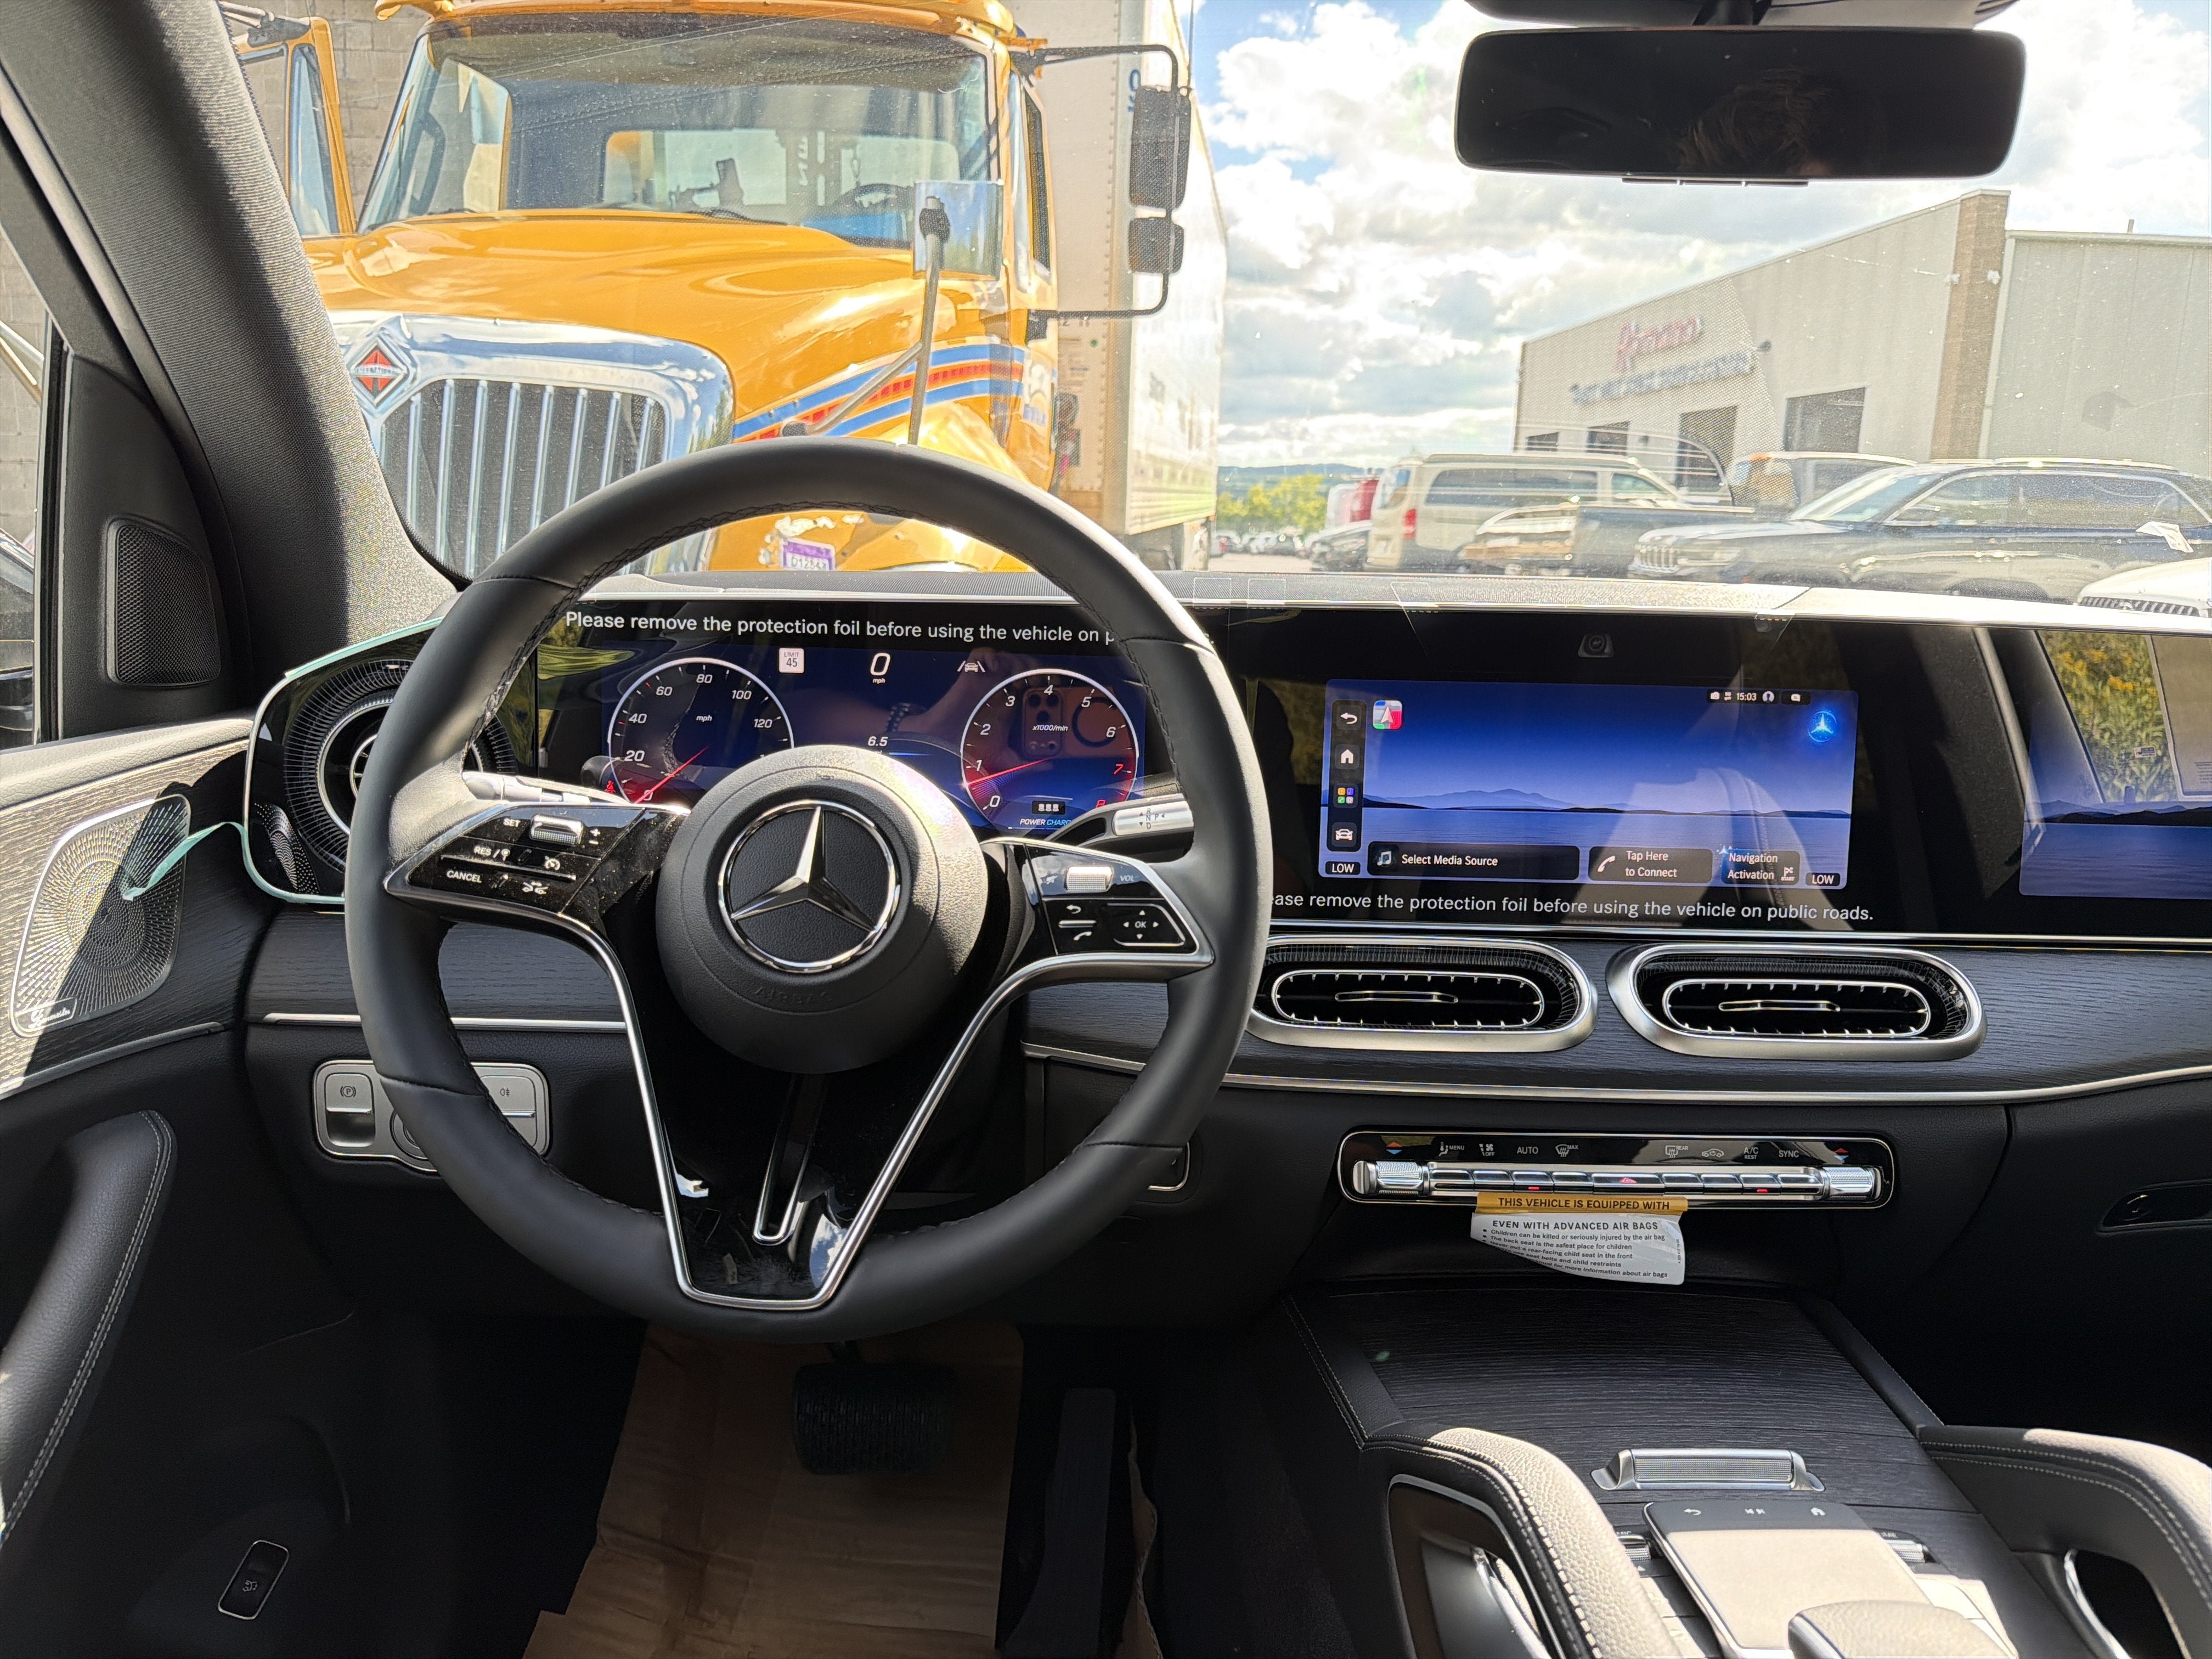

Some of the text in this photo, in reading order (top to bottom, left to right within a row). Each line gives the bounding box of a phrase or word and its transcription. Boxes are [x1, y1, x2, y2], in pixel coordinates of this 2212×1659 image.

[566, 611, 624, 628] Please
[631, 616, 697, 631] remove
[703, 616, 731, 631] the
[737, 617, 828, 635] protection
[834, 620, 860, 636] foil
[867, 621, 921, 638] before
[928, 624, 974, 642] using
[979, 624, 1007, 640] the
[1013, 625, 1073, 642] vehicle
[1079, 630, 1098, 642] on
[786, 658, 797, 667] 45
[870, 652, 890, 676] 0
[696, 673, 713, 684] 80
[656, 686, 673, 697] 60
[732, 690, 752, 700] 100
[1043, 685, 1053, 695] 4
[1005, 696, 1015, 707] 3
[1081, 696, 1091, 708] 5
[1736, 692, 1757, 701] 15:03
[629, 713, 647, 724] 40
[754, 718, 772, 729] 120
[980, 724, 991, 735] 2
[1032, 724, 1068, 732] x1000/min
[1106, 726, 1116, 738] 6
[868, 736, 888, 747] 6.5
[624, 751, 645, 761] 20
[975, 760, 982, 771] 1
[1113, 764, 1124, 775] 7
[989, 795, 1001, 807] 0
[503, 819, 521, 827] SET
[473, 846, 492, 856] RES
[1626, 850, 1668, 863] Tap Here
[1402, 854, 1498, 866] Select Media Source
[1729, 852, 1778, 865] Navigation
[1332, 864, 1354, 873] LOW
[1625, 867, 1677, 878] to Connect
[446, 870, 482, 883] CANCEL
[1728, 870, 1774, 880] Activation
[1812, 874, 1835, 885] LOW
[1310, 896, 1372, 908] remove
[1378, 895, 1403, 909] the
[1410, 896, 1496, 912] protection
[1503, 898, 1527, 911] foil
[1533, 898, 1588, 913] before
[1594, 901, 1639, 918] using
[1644, 901, 1671, 916] the
[1677, 902, 1736, 917] vehicle
[1741, 907, 1762, 917] on
[1767, 905, 1817, 921] public
[1823, 906, 1874, 920] roads.
[1135, 921, 1147, 929] OK
[1517, 1146, 1539, 1155] AUTO
[1743, 1147, 1759, 1155] A/C
[1778, 1150, 1799, 1158] SYNC
[1498, 1198, 1669, 1210] THIS VEHICLE IS EQUIPPED WITH
[1493, 1220, 1519, 1228] EVEN
[1523, 1221, 1549, 1229] WITH
[1528, 1248, 1562, 1257] rear-facing
[1583, 1267, 1621, 1275] information
